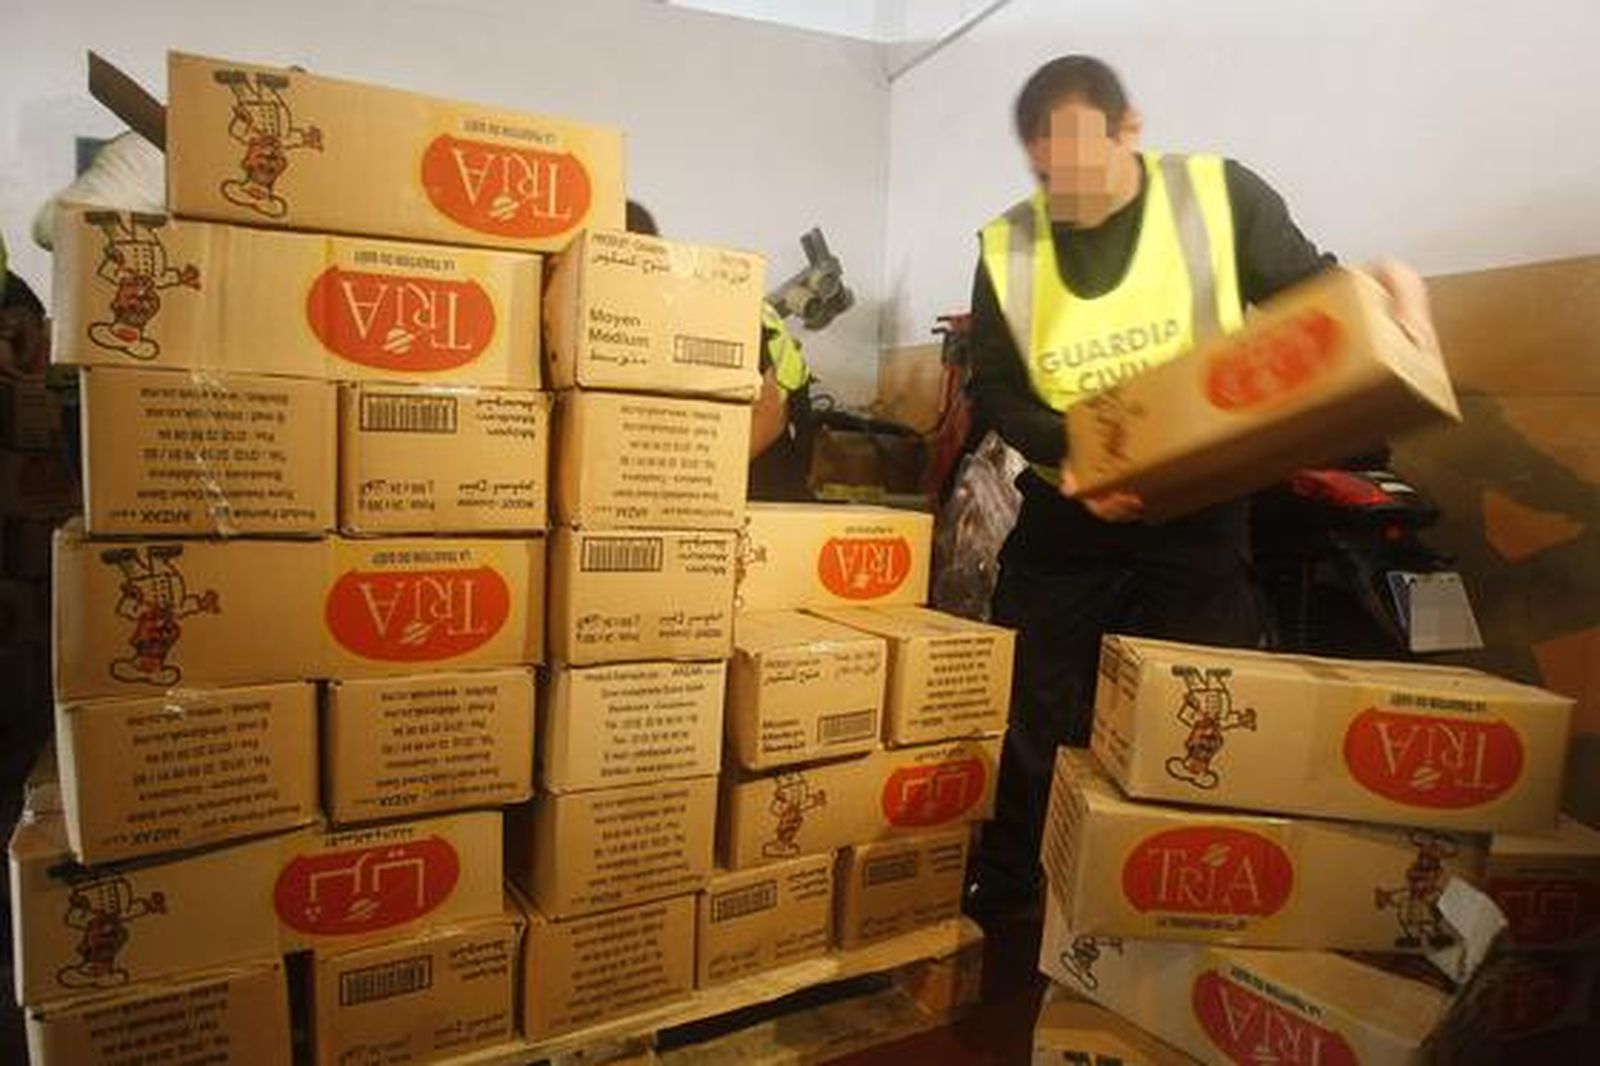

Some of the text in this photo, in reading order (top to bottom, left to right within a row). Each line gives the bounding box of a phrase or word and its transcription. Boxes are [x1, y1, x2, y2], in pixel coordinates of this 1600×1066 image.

[590, 308, 642, 328] Moyen
[589, 328, 651, 349] Medium
[1037, 317, 1180, 375] GUARDIA
